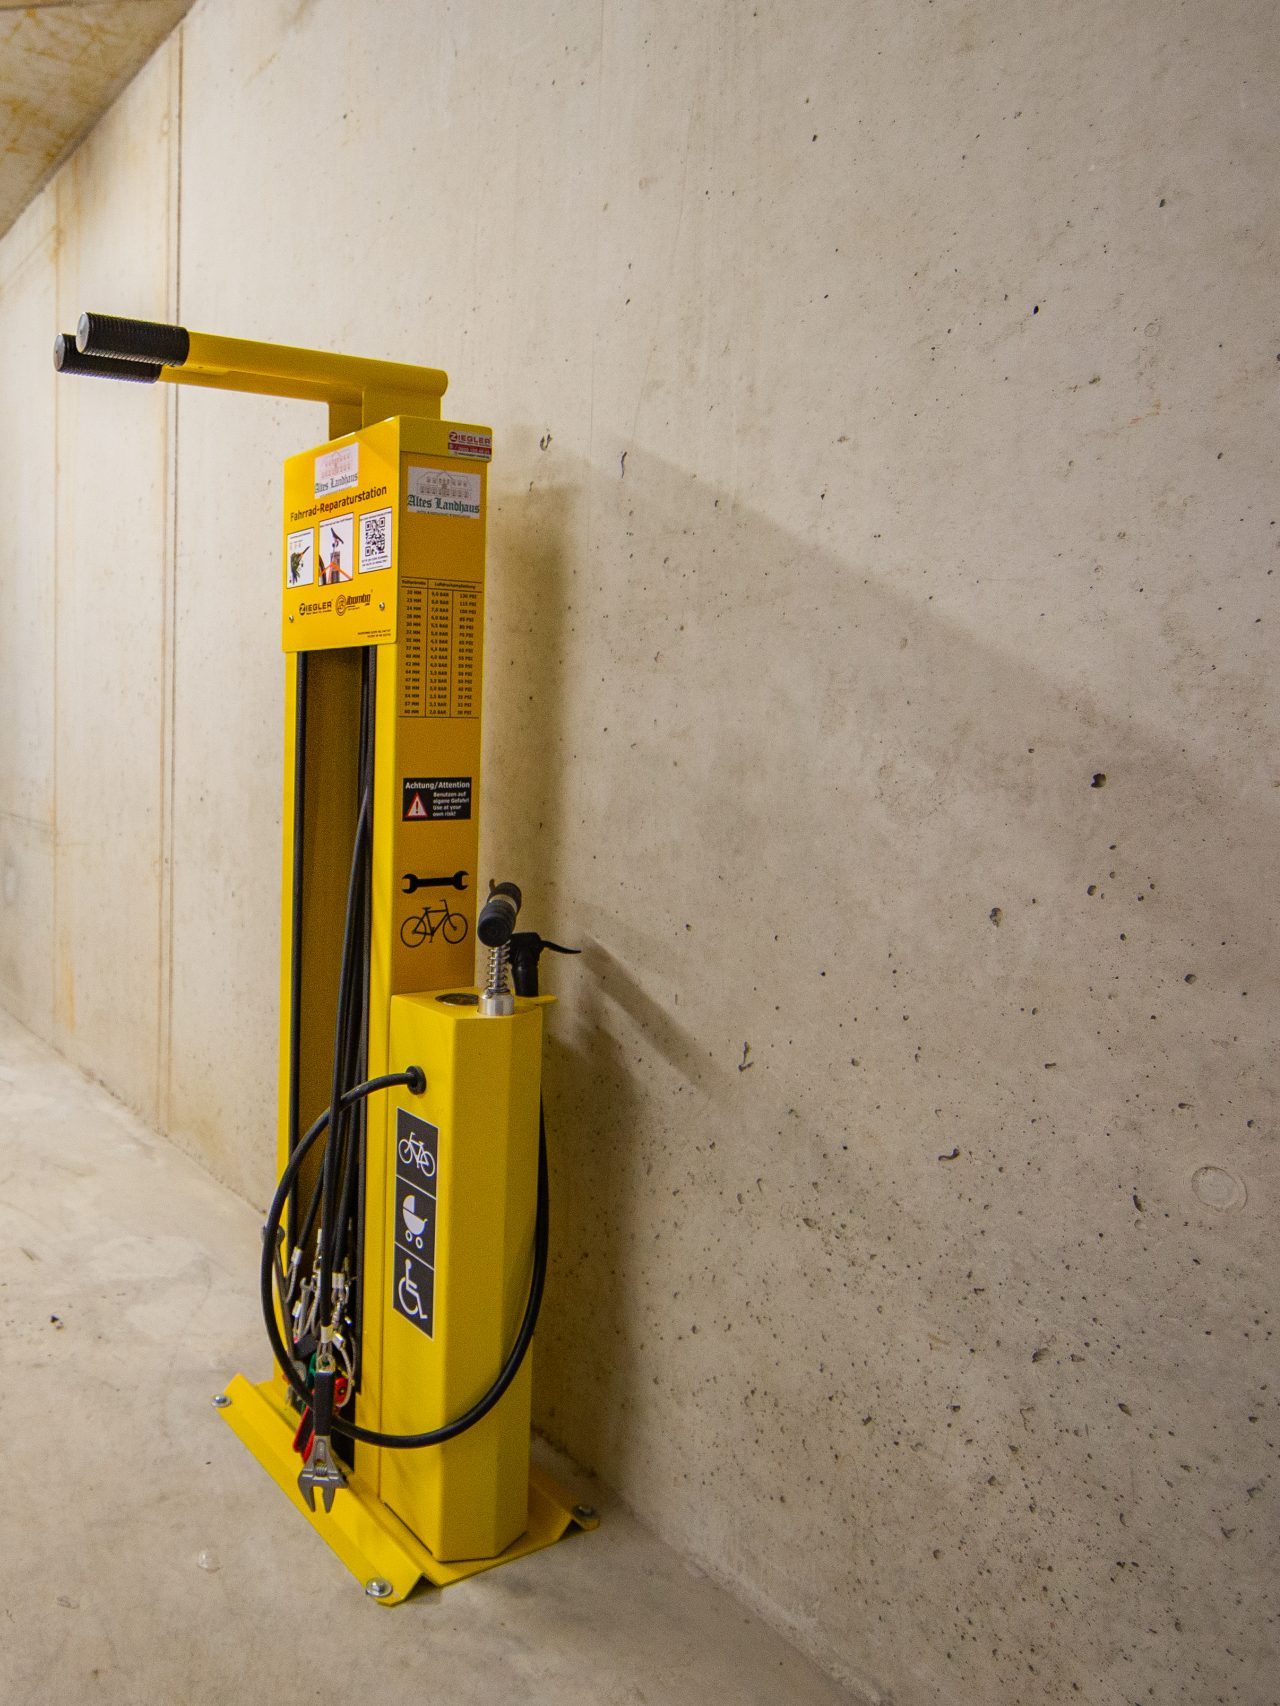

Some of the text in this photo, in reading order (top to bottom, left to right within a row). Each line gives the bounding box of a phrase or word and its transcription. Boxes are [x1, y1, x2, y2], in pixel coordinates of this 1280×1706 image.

[449, 431, 490, 444] ZIEGLER
[330, 473, 358, 488] Landhaus
[290, 485, 387, 522] Fahrrad-Reparaturstation
[408, 494, 480, 513] Altes Landhaus
[299, 601, 331, 615] ZIEGLER
[405, 781, 470, 790] Achtung/Attention
